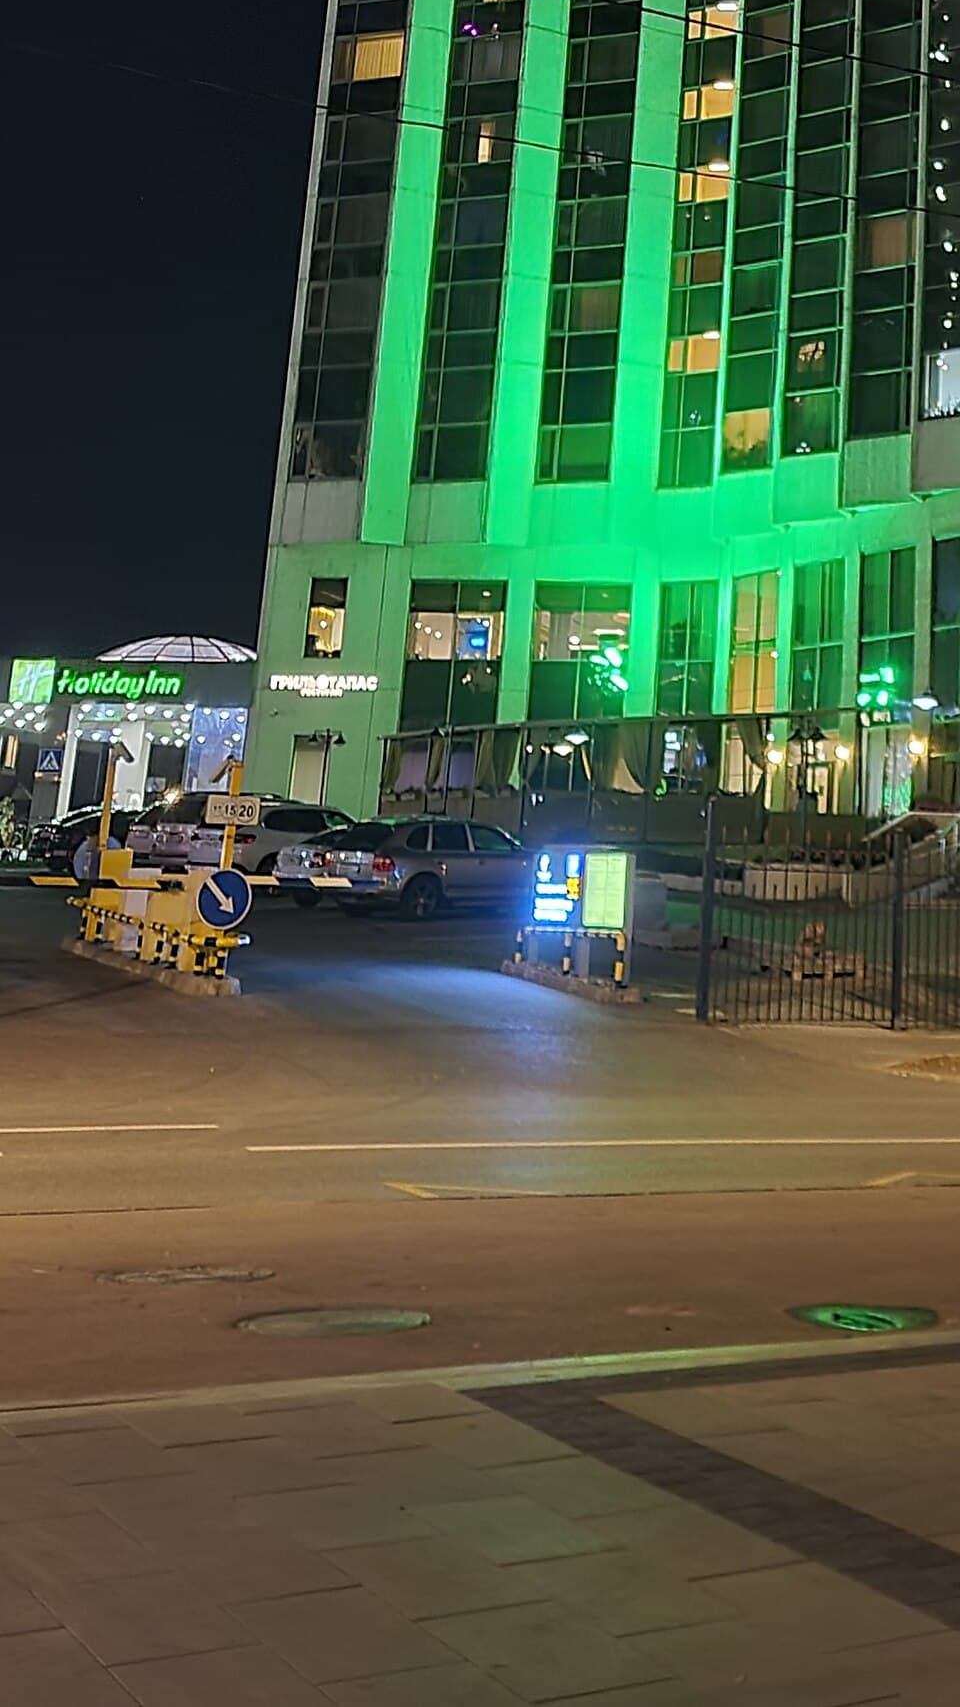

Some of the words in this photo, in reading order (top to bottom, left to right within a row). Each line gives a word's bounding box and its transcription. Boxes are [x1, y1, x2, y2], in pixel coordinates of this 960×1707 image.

[57, 669, 145, 699] Holiday
[144, 669, 181, 695] Inn
[239, 804, 254, 817] 20
